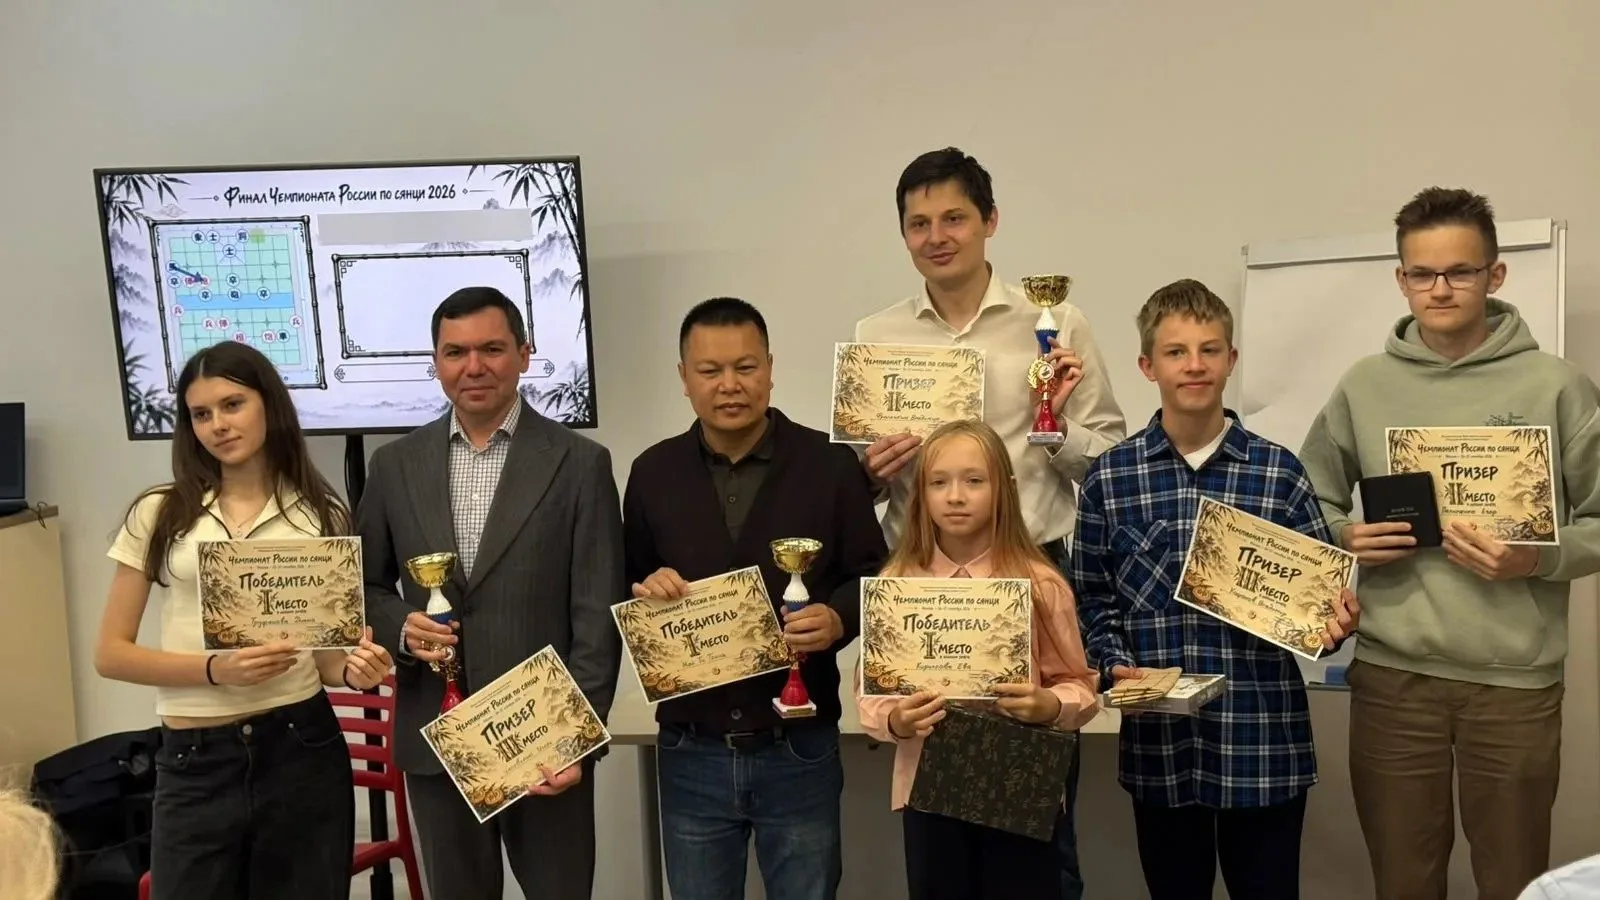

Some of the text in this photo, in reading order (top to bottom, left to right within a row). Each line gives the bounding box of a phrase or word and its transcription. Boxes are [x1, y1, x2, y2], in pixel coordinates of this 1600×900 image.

[379, 188, 392, 200] по
[427, 184, 457, 200] 2026
[883, 373, 936, 391] Призер
[1440, 461, 1499, 481] Призер
[1237, 546, 1302, 583] Призер
[238, 572, 325, 591] Победитель
[660, 609, 738, 640] Победитель
[902, 613, 991, 634] Победитель
[480, 698, 536, 746] Призер
